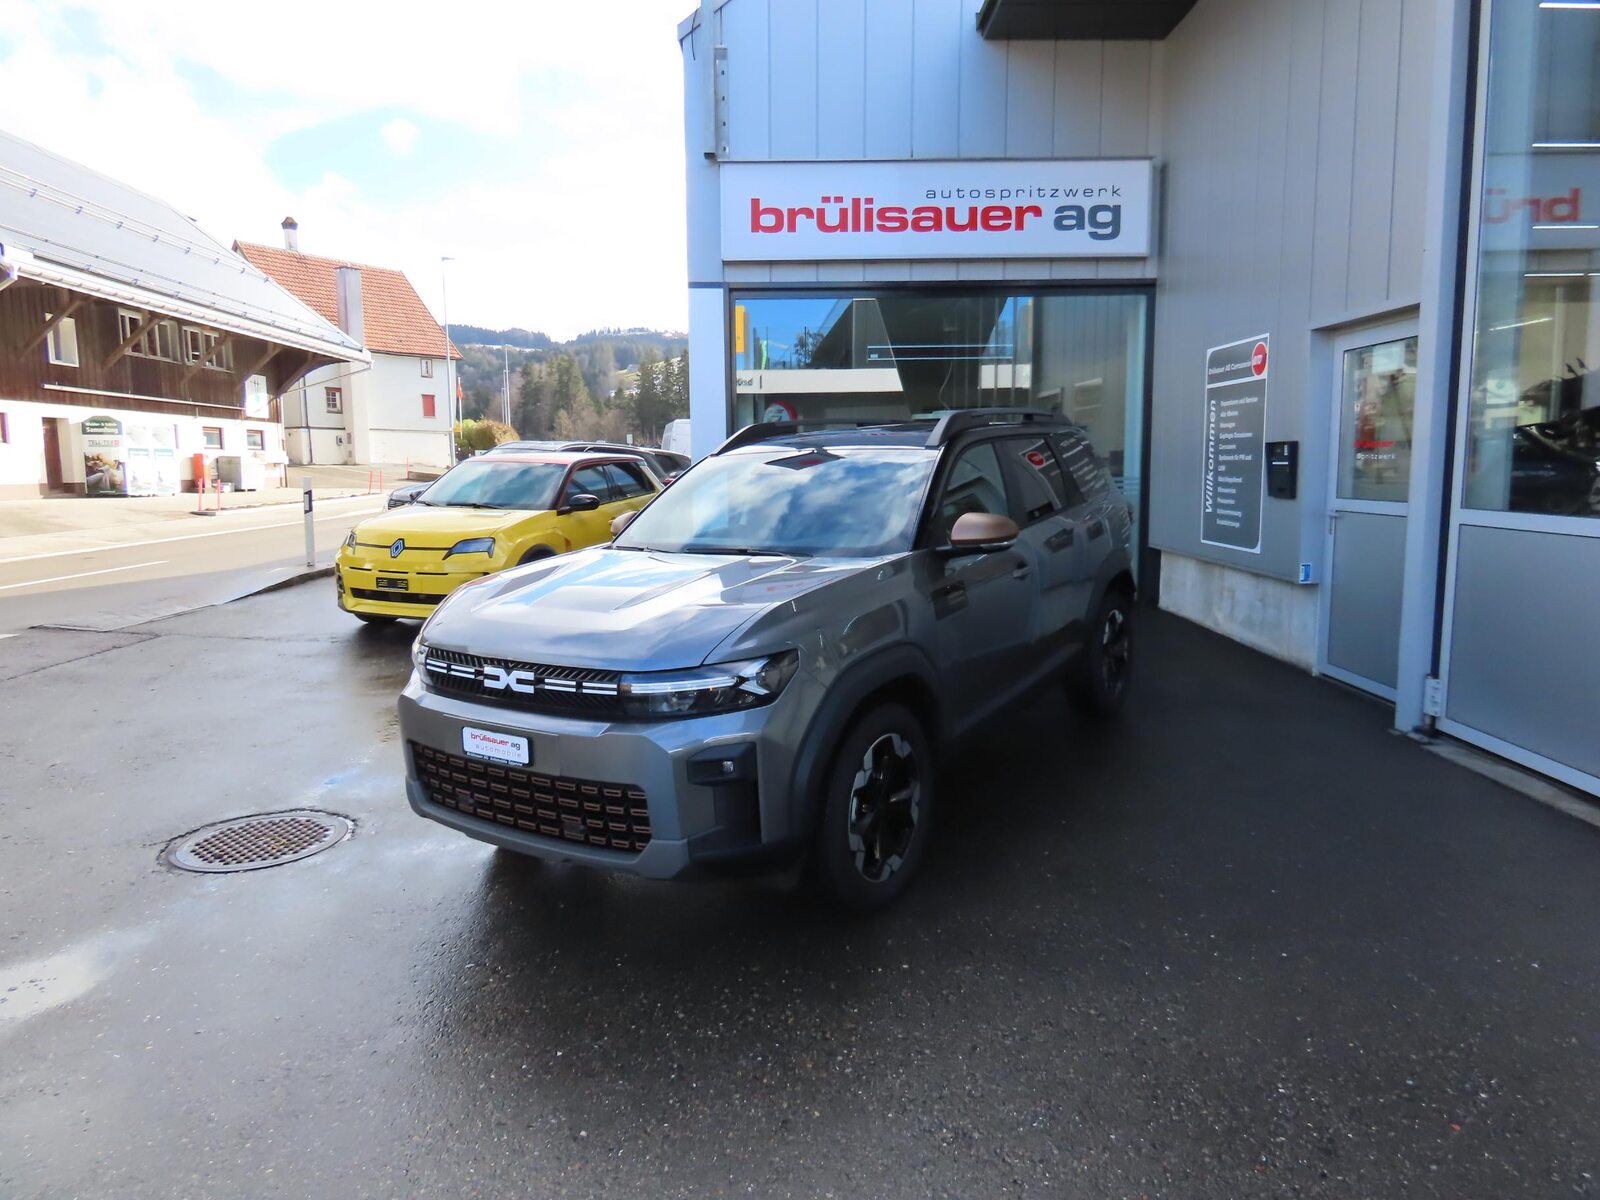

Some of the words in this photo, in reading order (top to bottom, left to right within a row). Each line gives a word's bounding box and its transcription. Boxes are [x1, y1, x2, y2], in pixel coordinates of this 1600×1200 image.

[925, 184, 1122, 200] autospritzwerk
[750, 196, 1042, 234] brülisauer
[1053, 203, 1122, 241] ag
[1205, 400, 1217, 513] Willkommen
[471, 732, 509, 746] brülisauer
[511, 742, 520, 750] ag
